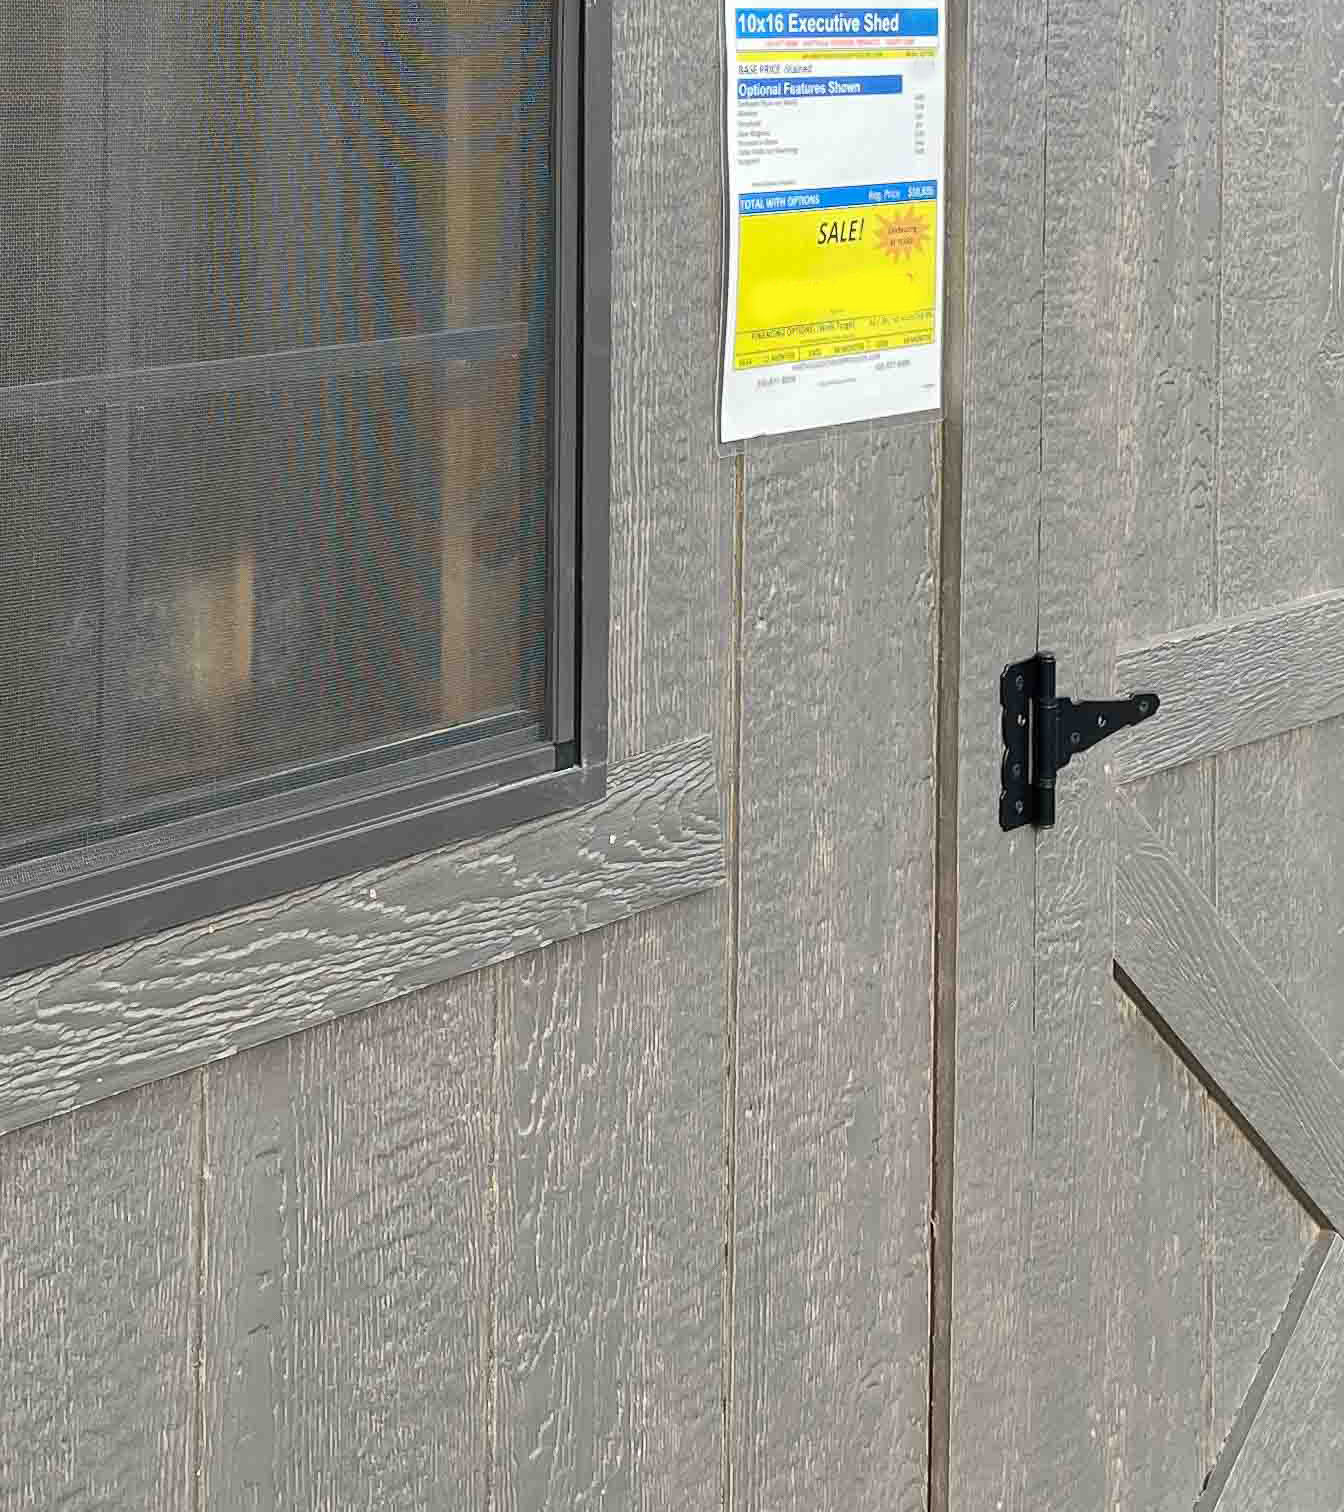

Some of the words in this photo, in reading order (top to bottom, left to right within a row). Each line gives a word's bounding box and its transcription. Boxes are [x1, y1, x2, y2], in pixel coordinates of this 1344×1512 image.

[737, 14, 784, 33] 10x16
[788, 13, 860, 33] Executive
[864, 13, 899, 32] Shed
[738, 83, 782, 97] Optional
[784, 81, 826, 96] Features
[828, 80, 861, 94] Shown
[740, 198, 764, 209] TOTAL
[766, 196, 785, 208] WITH
[787, 194, 820, 207] OPTIONS
[817, 218, 864, 245] SALE!
